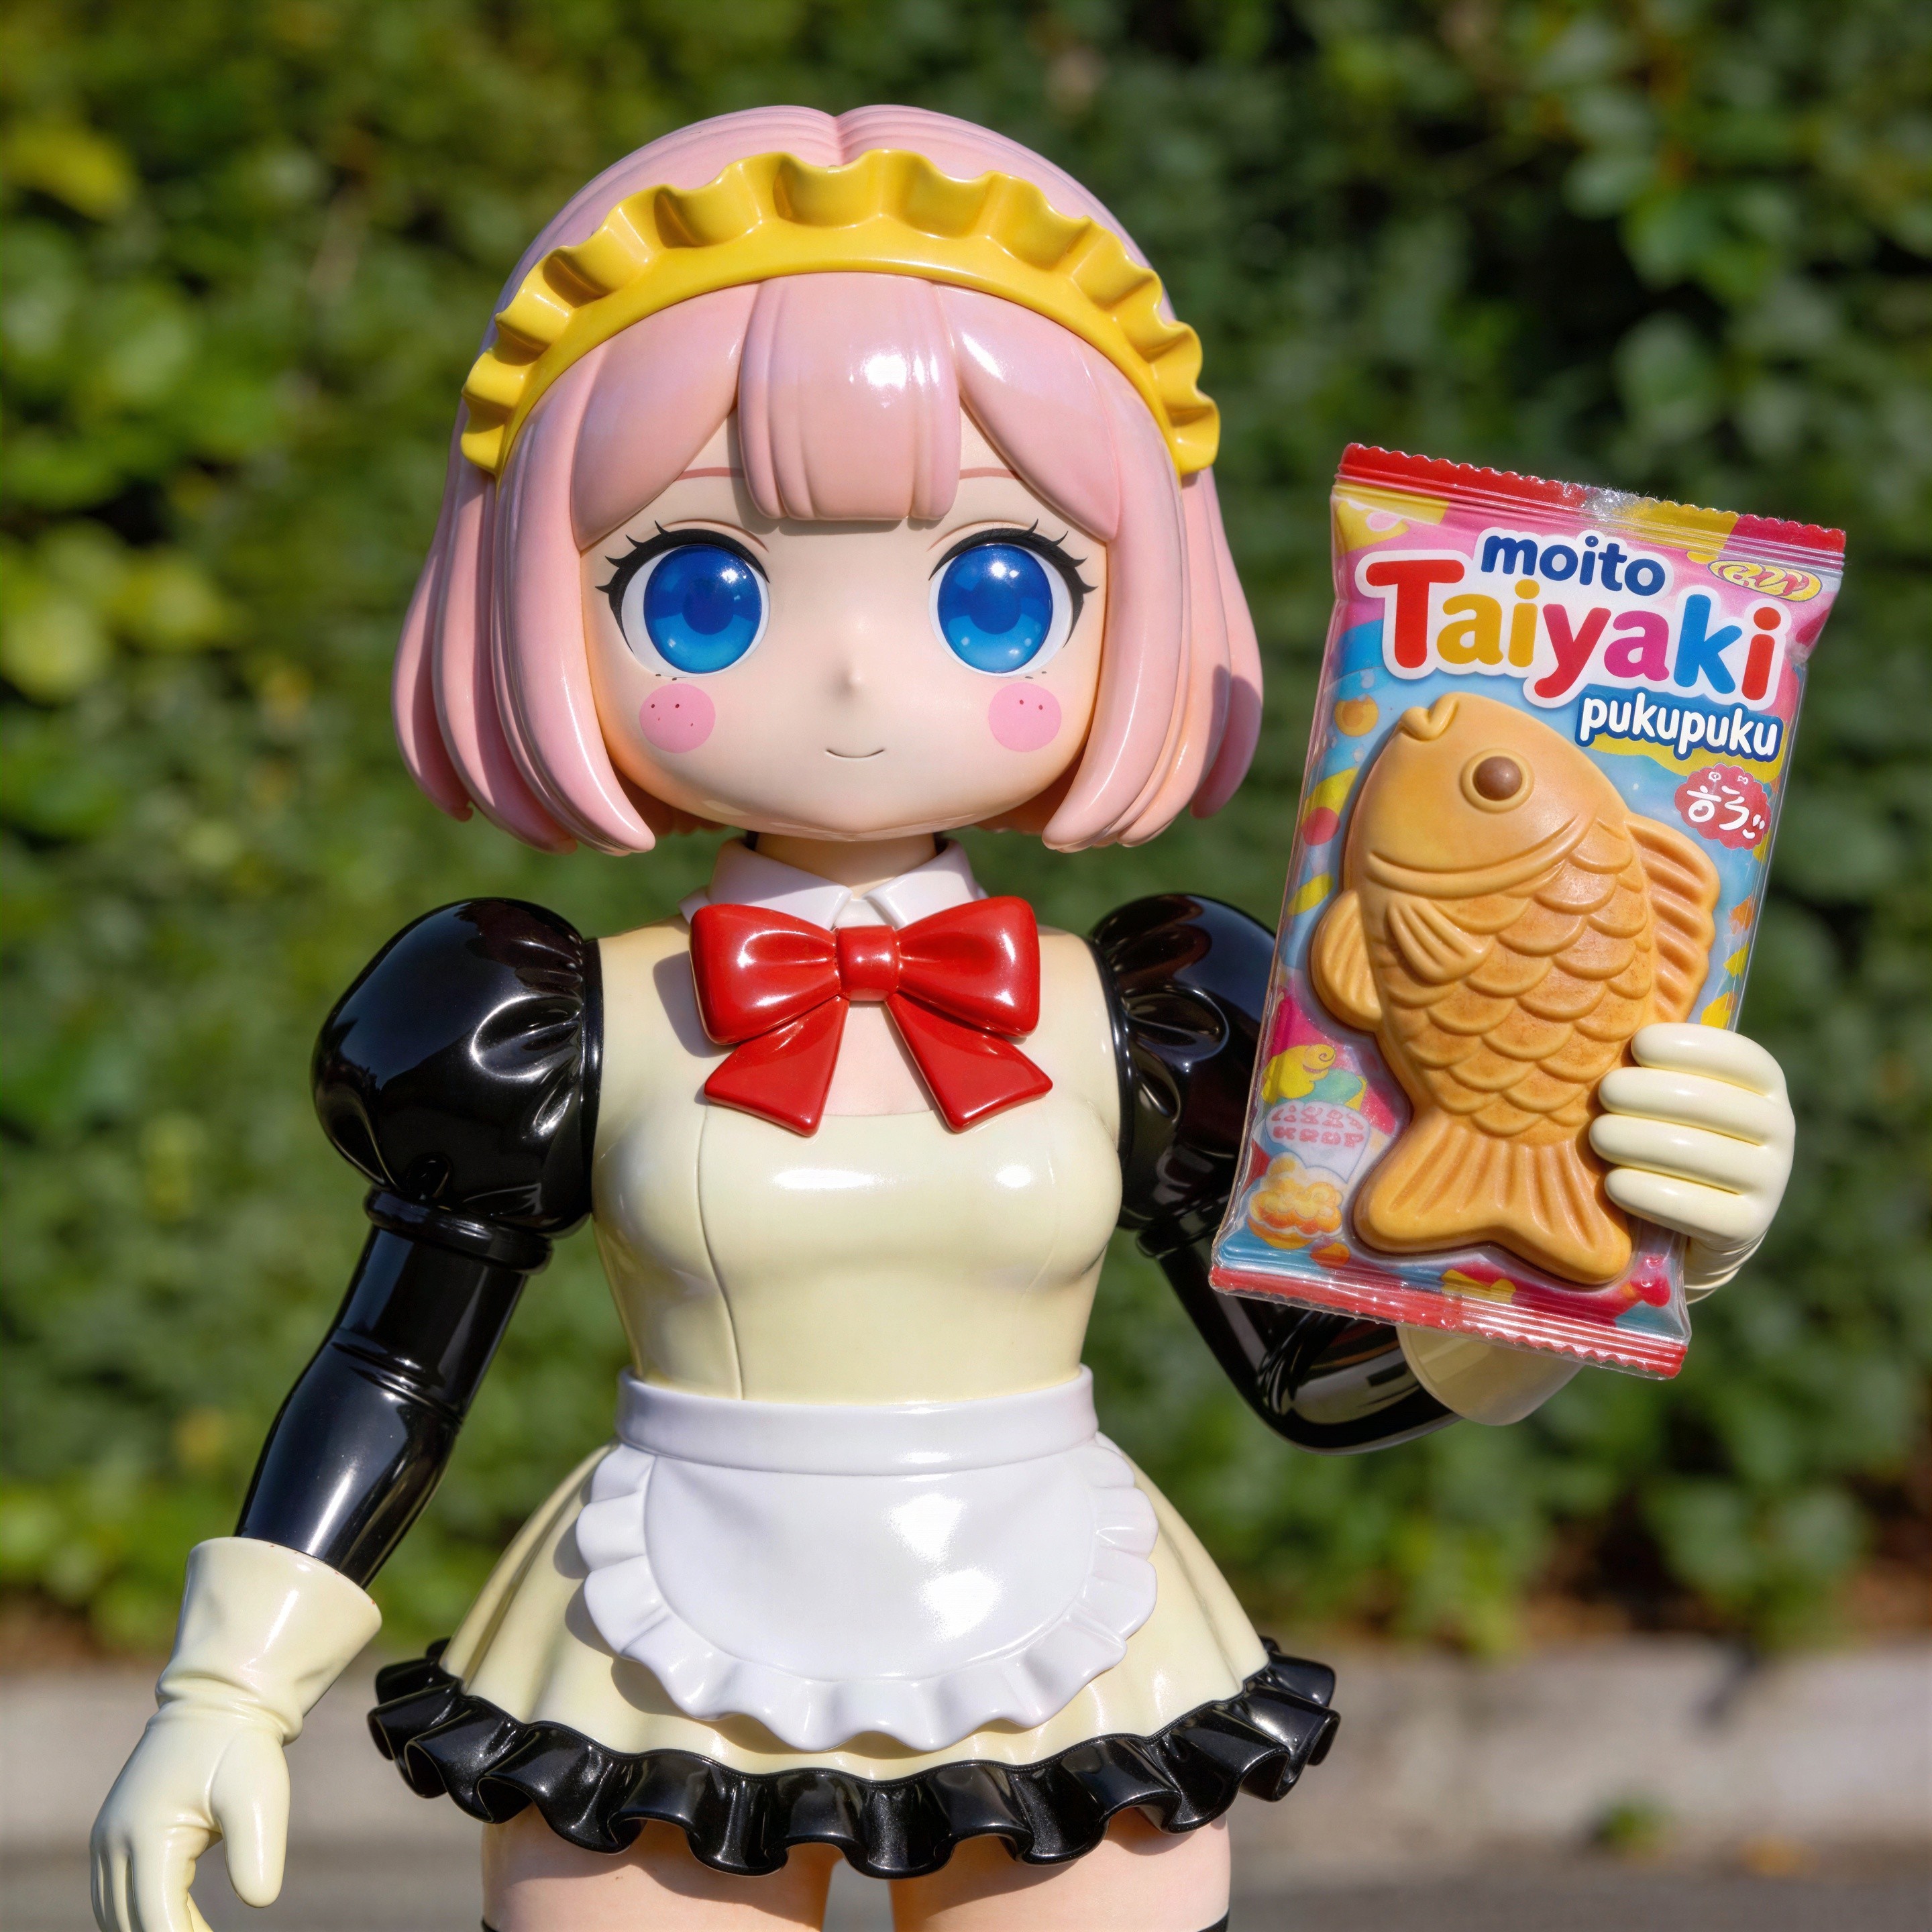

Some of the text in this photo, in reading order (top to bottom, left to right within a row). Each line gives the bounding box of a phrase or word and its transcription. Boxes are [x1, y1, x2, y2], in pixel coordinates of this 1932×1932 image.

[1481, 535, 1666, 595] moito
[1366, 559, 1782, 700] Taiyaki
[1580, 693, 1778, 757] pukupuku
